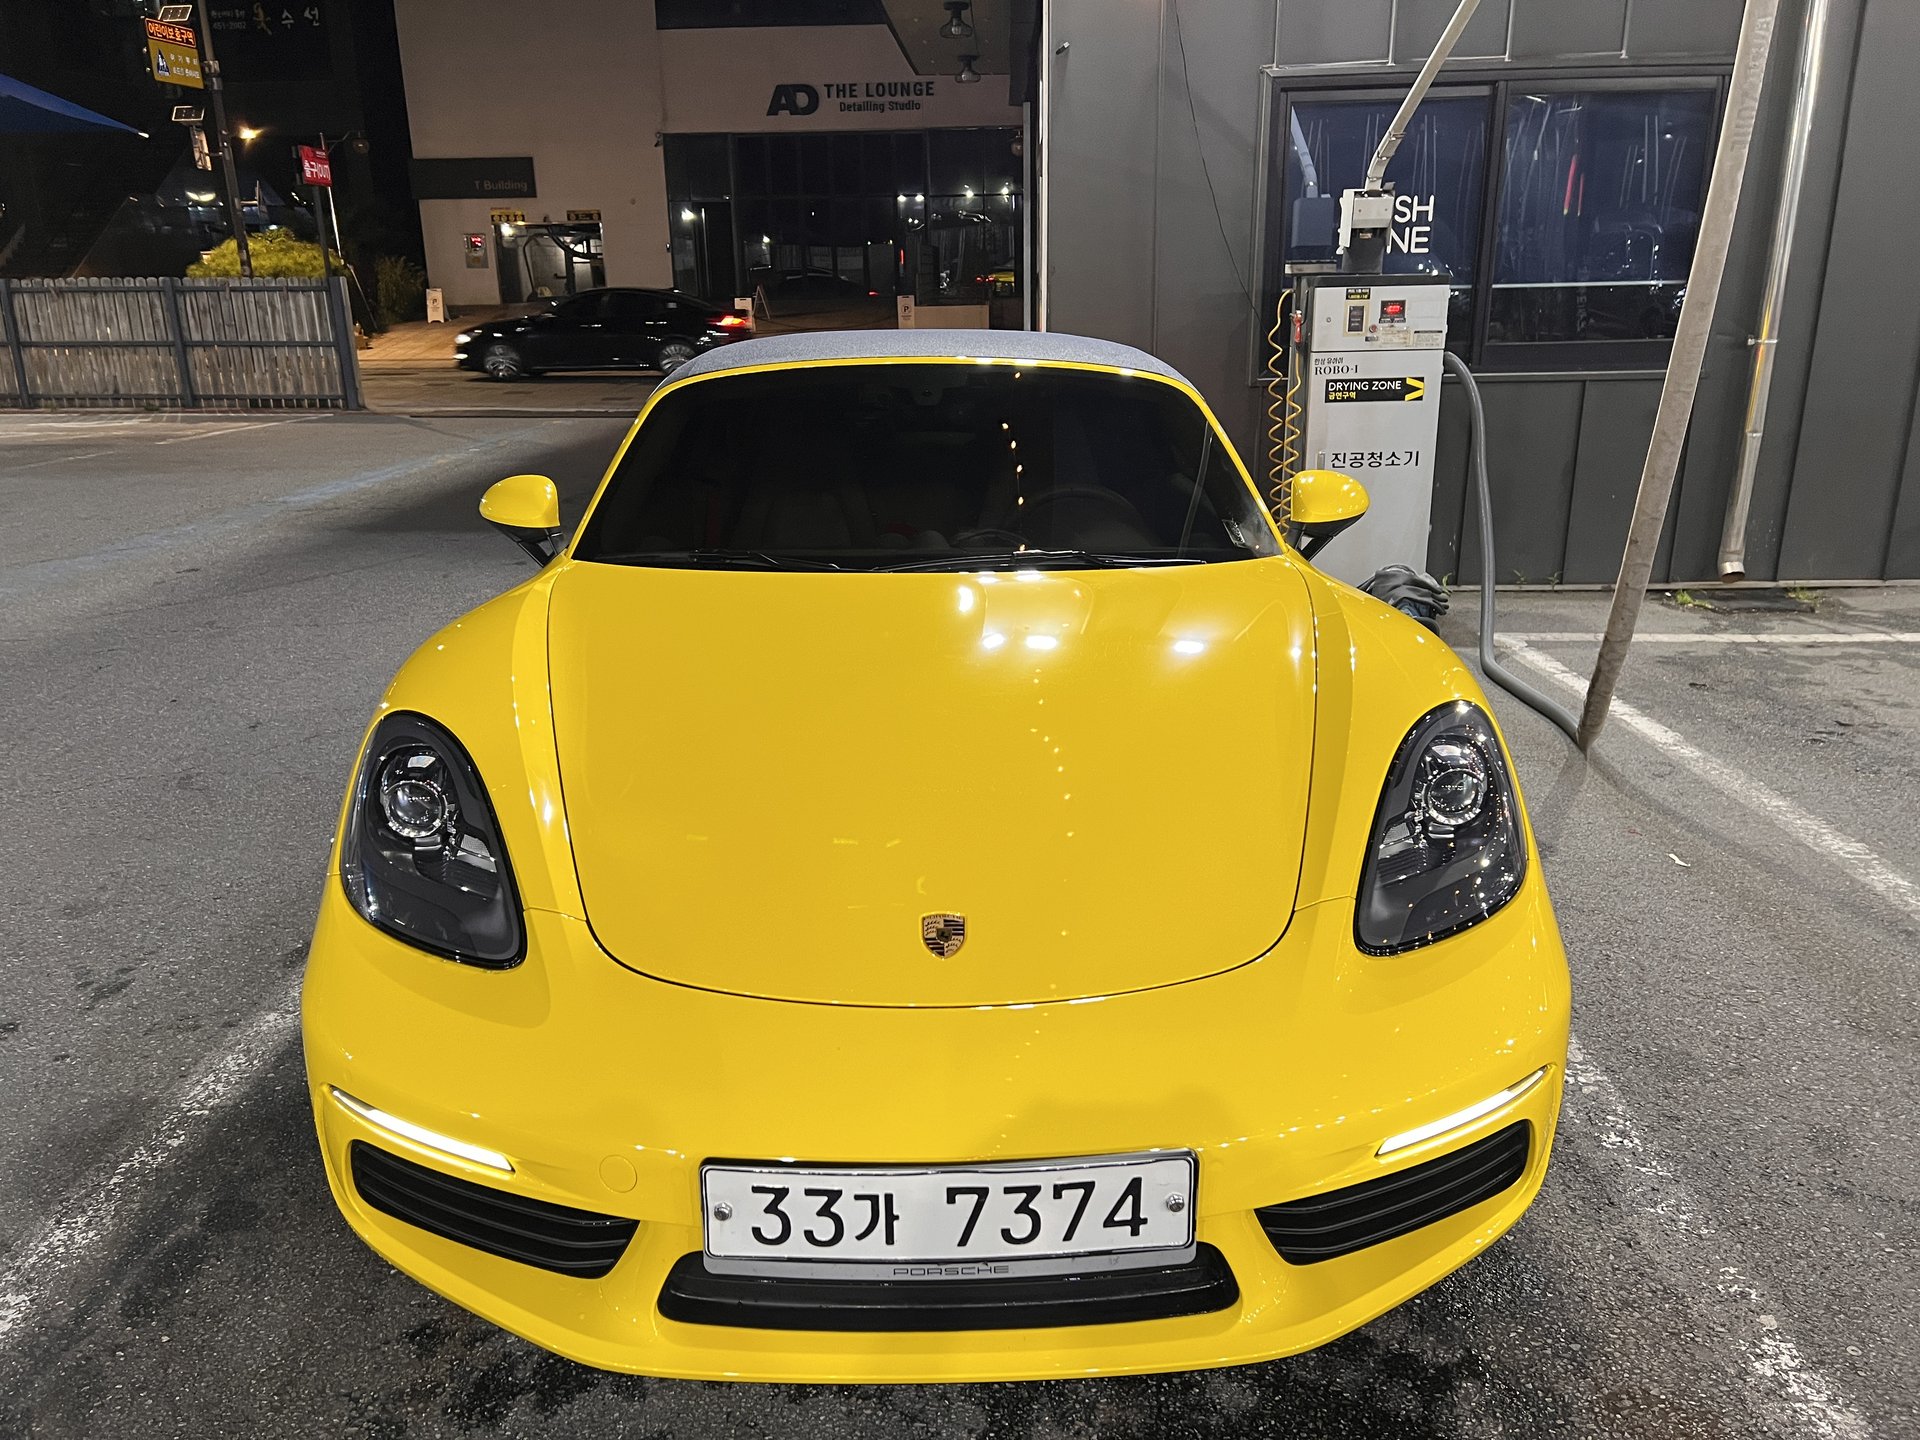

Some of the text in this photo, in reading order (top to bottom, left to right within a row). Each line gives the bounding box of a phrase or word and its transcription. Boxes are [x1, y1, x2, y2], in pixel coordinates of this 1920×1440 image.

[148, 22, 195, 44] 어린이보호구역
[824, 83, 858, 99] THE
[865, 81, 935, 98] LOUNGE
[839, 100, 921, 114] Detailing Studio
[483, 179, 528, 192] Building
[1328, 380, 1402, 392] DRYING ZONE
[1328, 391, 1357, 400] 금연구역
[1331, 450, 1420, 469] 진공청소기
[750, 1176, 1149, 1248] 33가 7374
[893, 1265, 1010, 1276] PORSCHE
